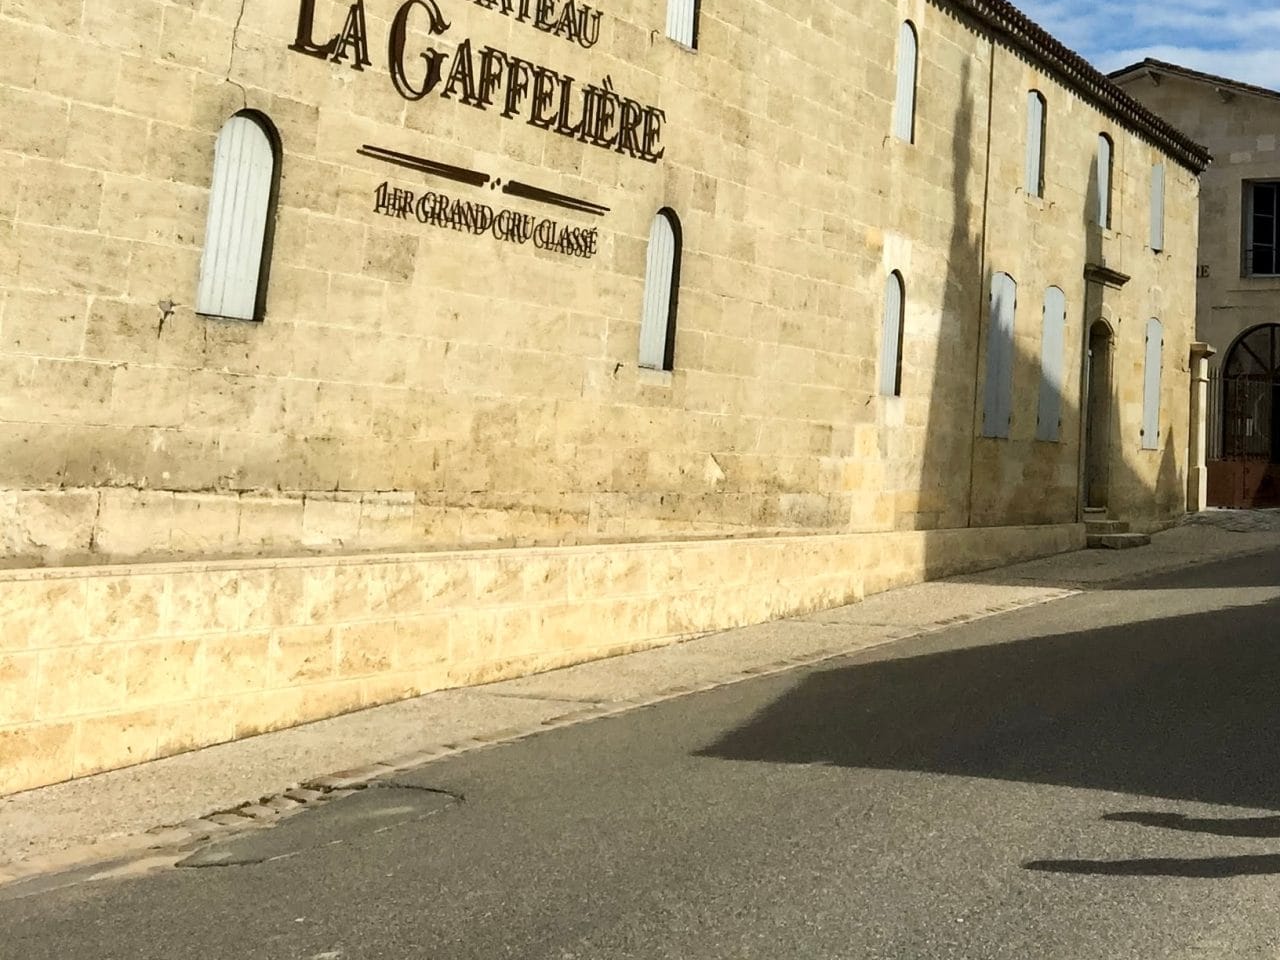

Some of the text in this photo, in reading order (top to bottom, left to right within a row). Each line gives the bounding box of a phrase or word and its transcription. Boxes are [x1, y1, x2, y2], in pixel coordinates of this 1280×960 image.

[373, 181, 598, 259] 1ER GRAND CRU CLASSÉ
